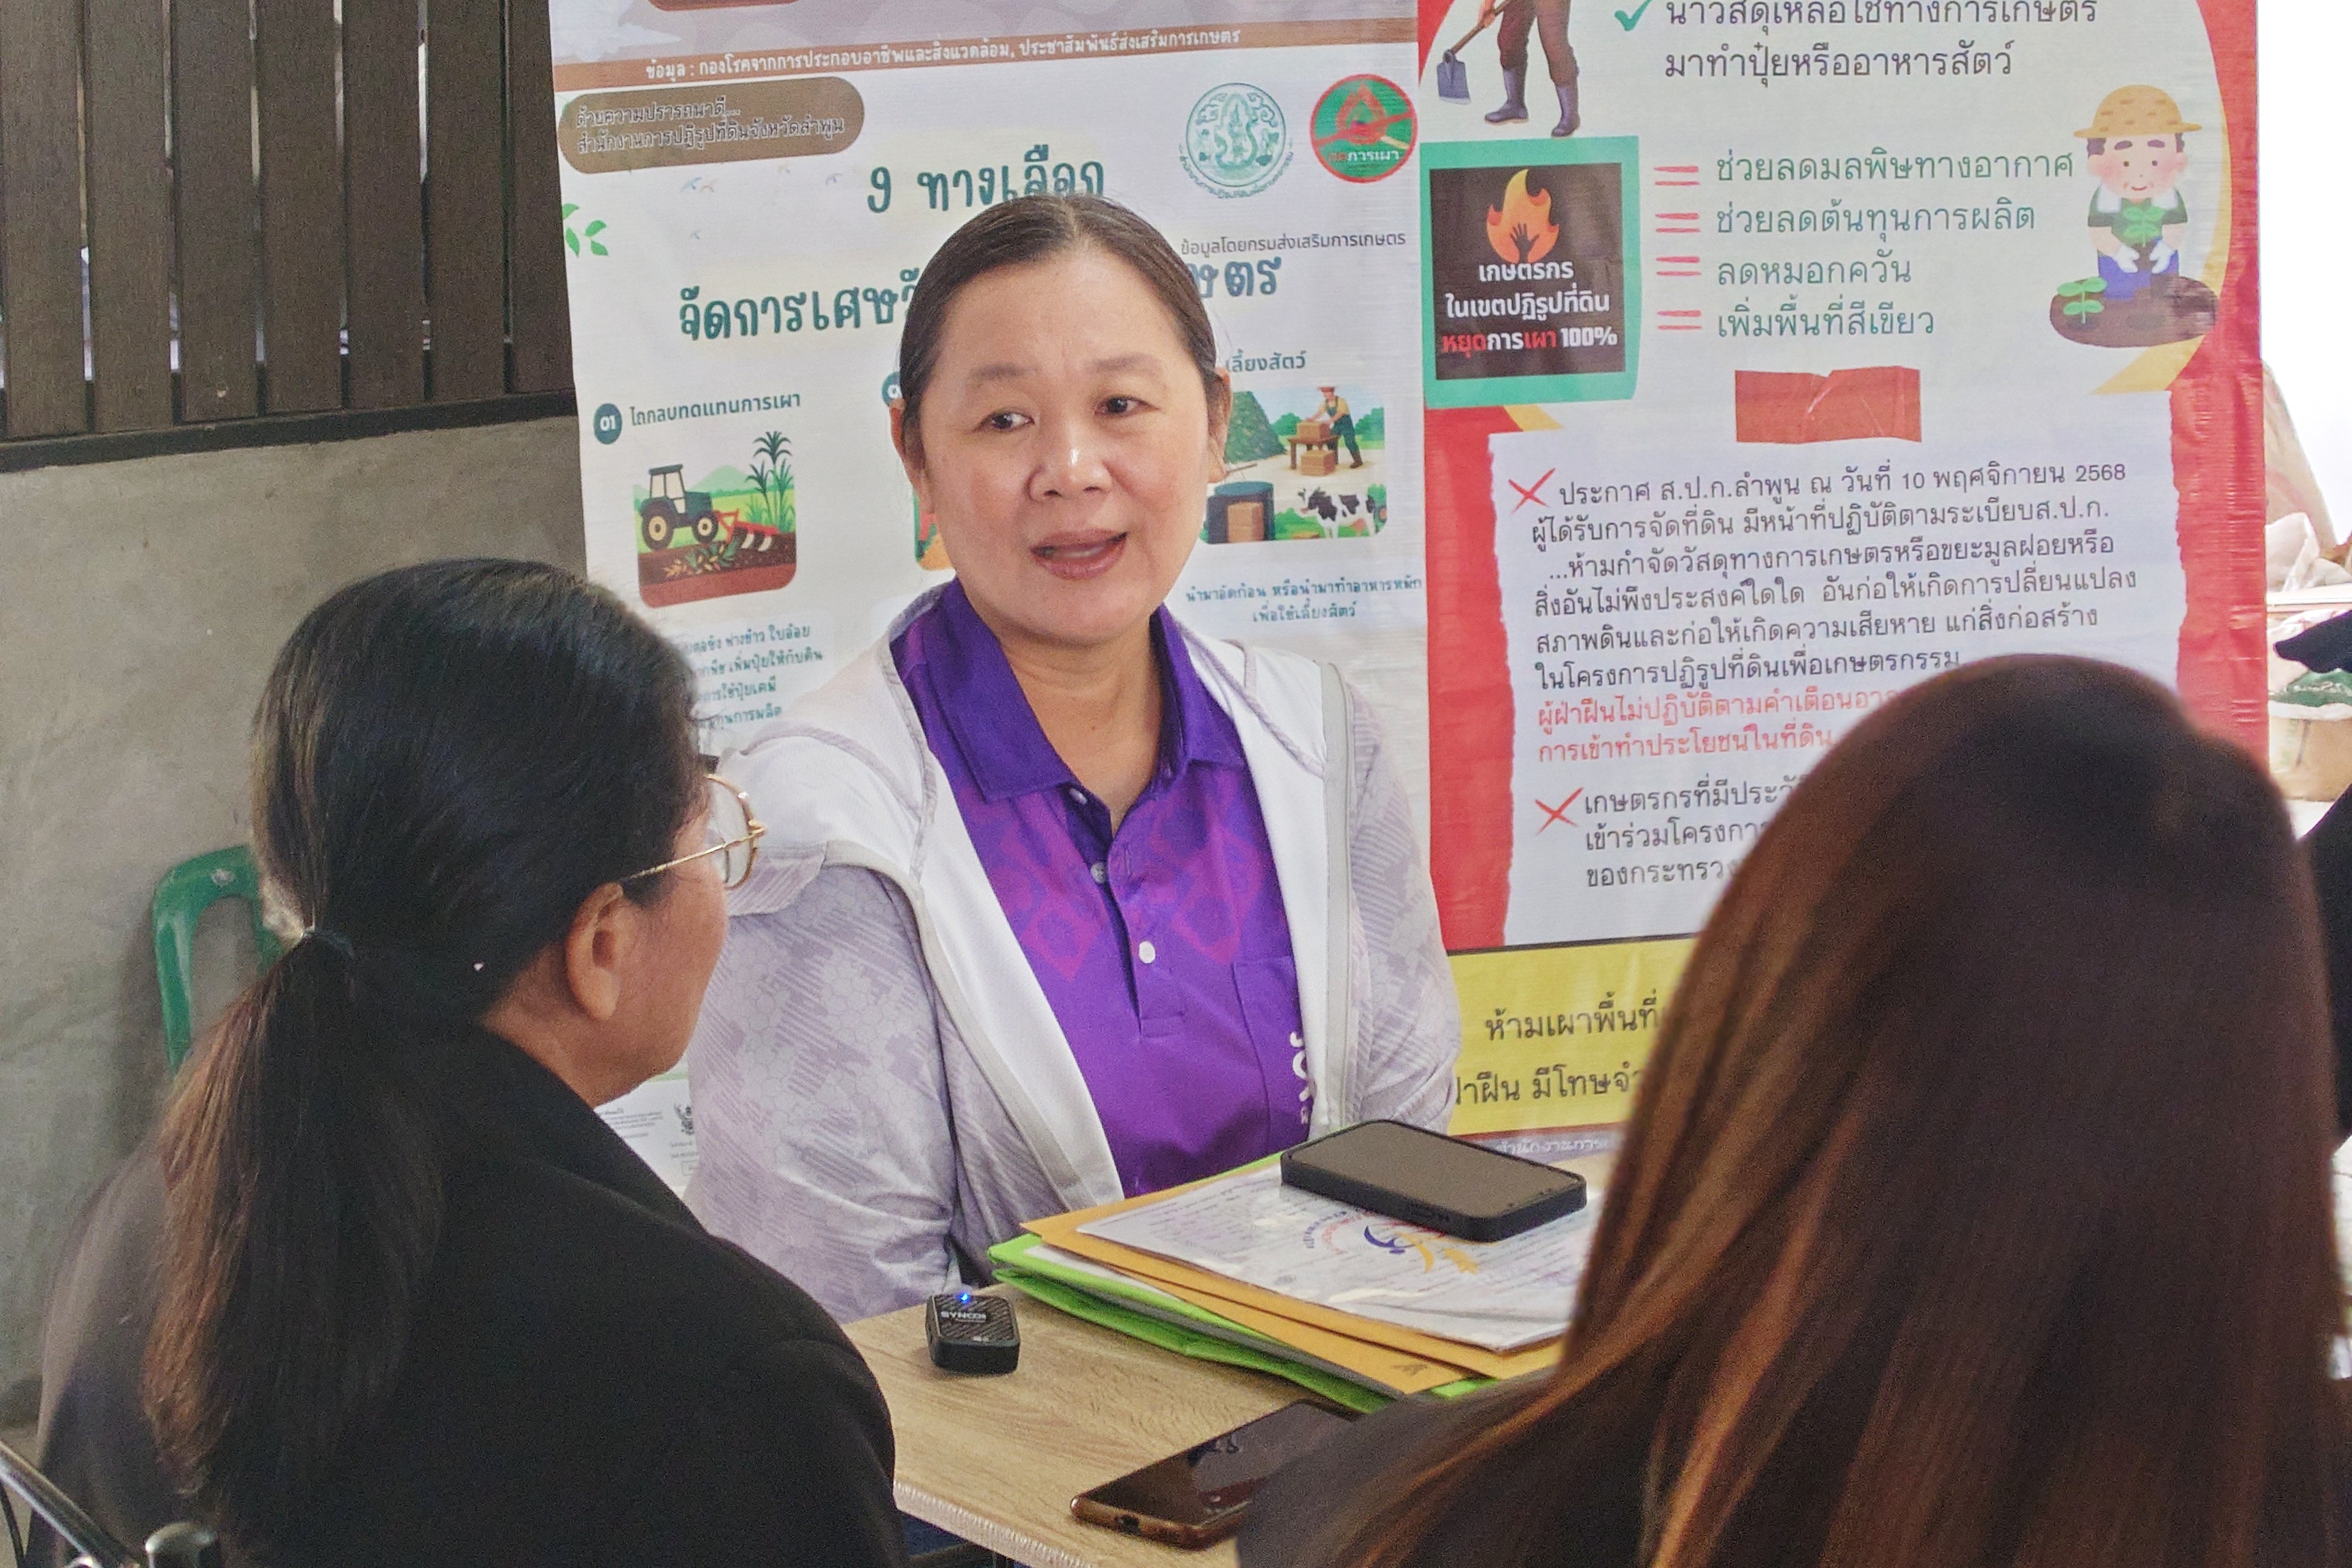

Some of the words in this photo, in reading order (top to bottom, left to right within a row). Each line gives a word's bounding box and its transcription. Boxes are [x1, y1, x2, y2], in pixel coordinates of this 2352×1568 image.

[1665, 40, 2015, 87] มาทำปุ๋ยหรืออาหารสัตว์
[1717, 146, 2073, 181] ช่วยลดมลพิษทางอากาศ
[1717, 197, 2035, 242] ช่วยลดต้นทุนการผลิต
[1181, 233, 1406, 258] ข้อมูลโดยกรมส่งเสริมการเกษตร
[1479, 261, 1574, 282] เกษตรกร
[1717, 249, 1912, 286] ลดหมอกควัน
[1444, 282, 1610, 321] ในเขตปฏิรูปที่ดิน
[1718, 293, 1934, 337] เพิ่มพื้นที่สีเขียว
[1442, 330, 1557, 359] หยุดการเผา
[1560, 326, 1618, 347] 100%
[600, 415, 616, 431] 01
[629, 393, 801, 426] ไถกลบทดแทนการเผา
[1559, 481, 1650, 506] ประกาศ
[1661, 471, 1800, 504] ส.ป.ก.ลำพูน
[1811, 476, 1831, 493] ณ
[1842, 459, 1891, 492] วันที่
[1902, 472, 1925, 489] 10
[1933, 460, 2064, 492] พฤศจิกายน
[2076, 464, 2126, 482] 2568
[1532, 504, 1734, 552] ผู้ได้รับการจัดที่ดิน
[1536, 610, 1936, 654] สภาพดินและก่อให้เกิดความเสียหาย
[1946, 598, 2098, 633] แก่สิ่งก่อสร้าง
[1587, 817, 1770, 850] เข้าร่วมโครงกา
[1486, 988, 1660, 1041] ห้ามเผาพื้นที่
